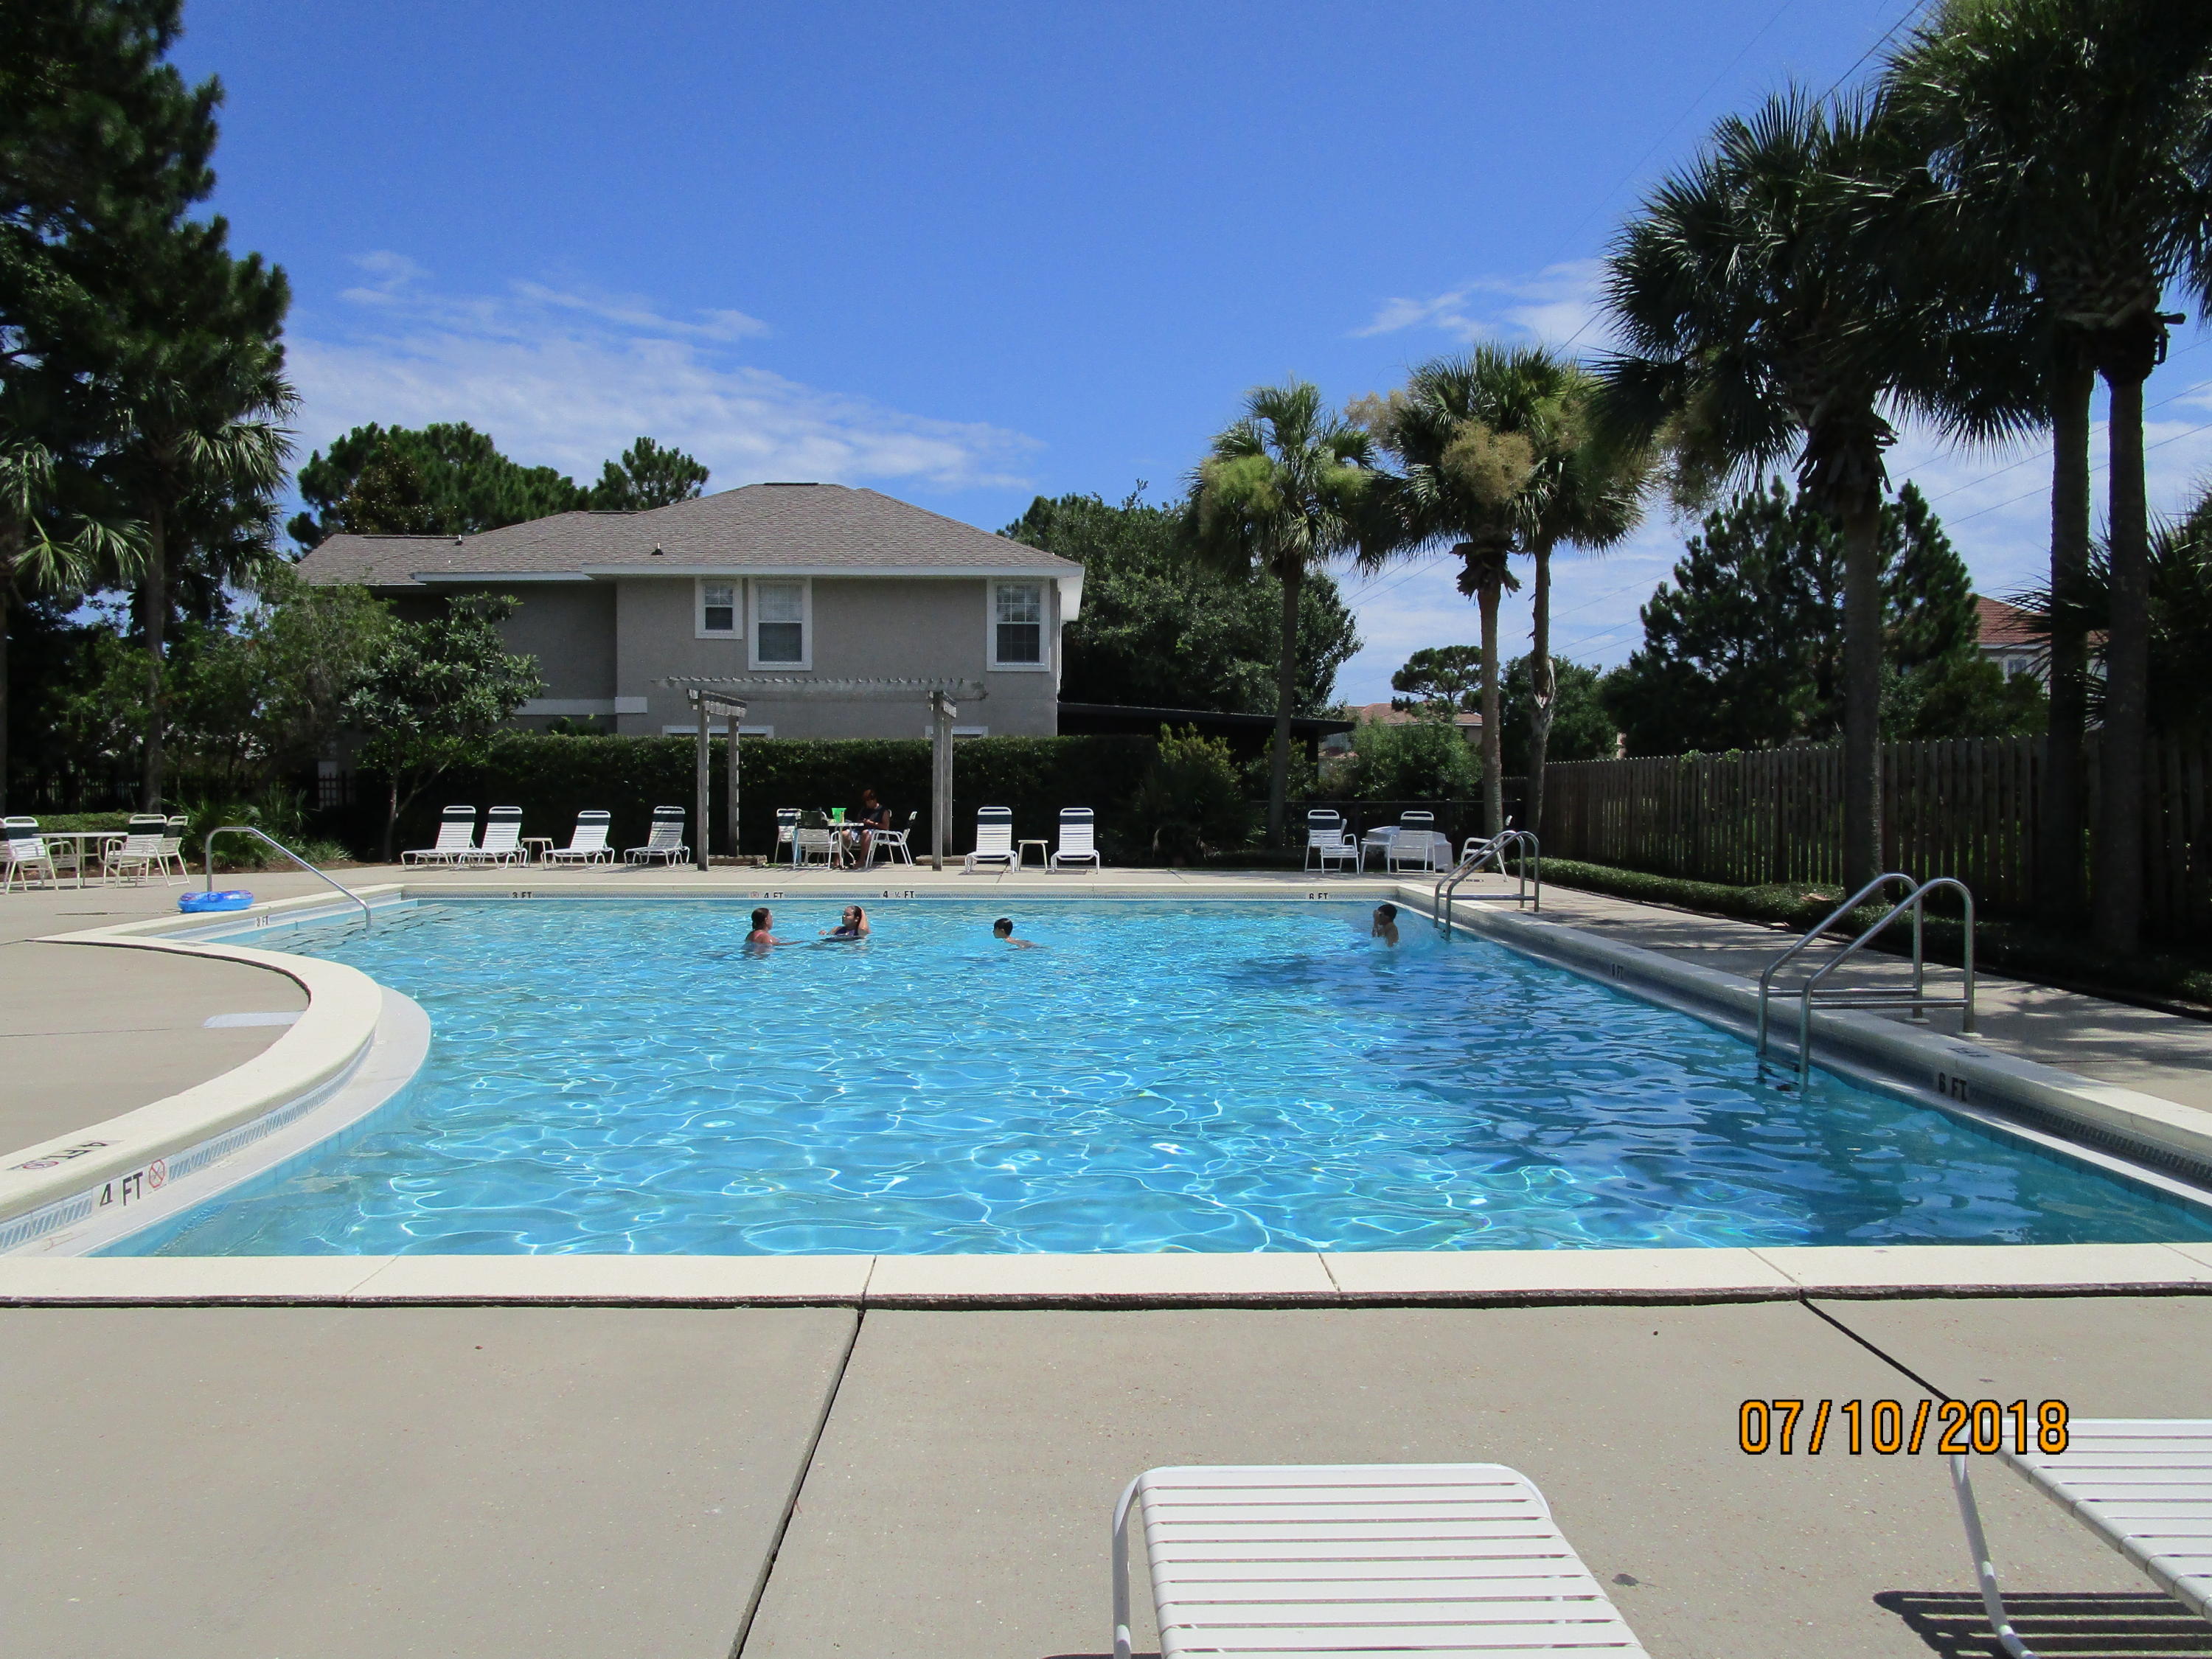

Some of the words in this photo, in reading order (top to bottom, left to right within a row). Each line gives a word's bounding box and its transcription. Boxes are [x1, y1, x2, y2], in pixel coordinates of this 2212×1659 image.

[1938, 1072, 1946, 1093] 6
[1952, 1077, 1967, 1102] FT
[100, 1183, 113, 1207] 4
[122, 1171, 143, 1206] FT
